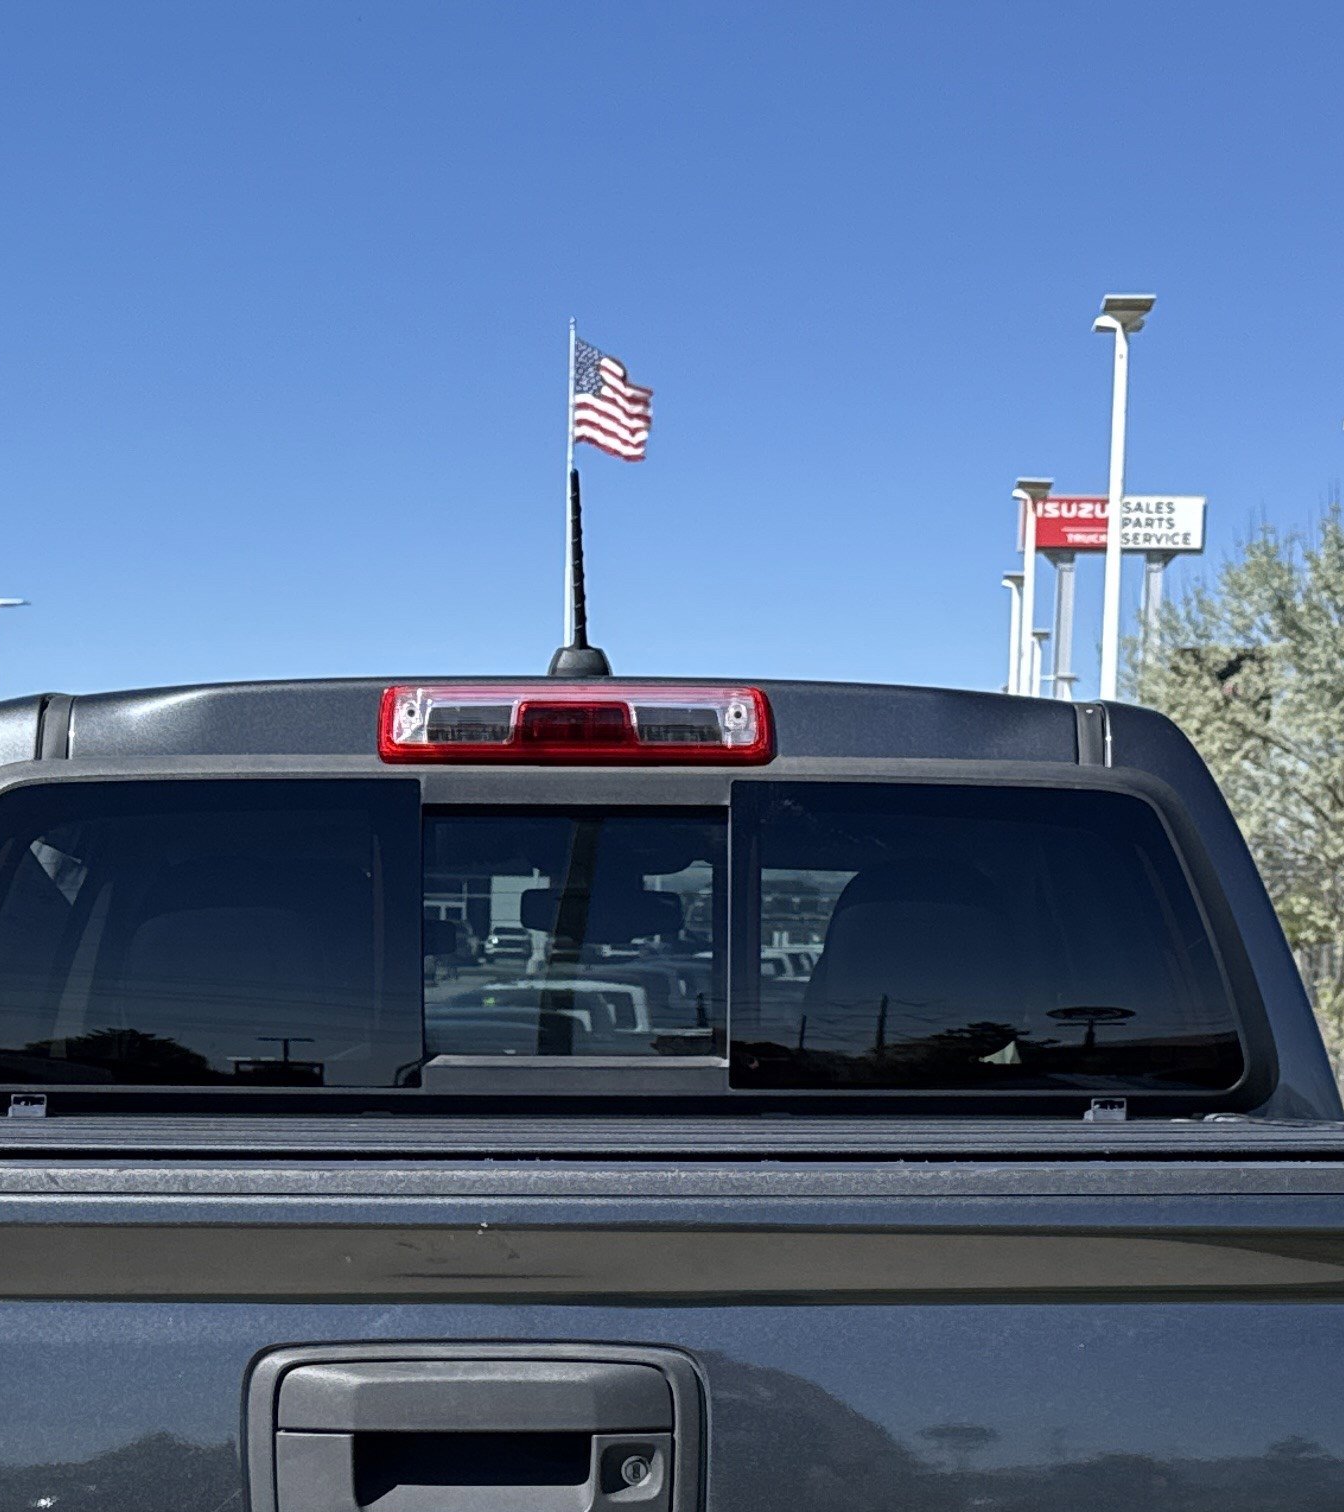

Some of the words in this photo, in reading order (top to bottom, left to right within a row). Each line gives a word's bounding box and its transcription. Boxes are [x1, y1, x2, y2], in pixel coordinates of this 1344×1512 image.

[1037, 501, 1110, 519] ISUZU
[1121, 501, 1176, 514] SALES
[1121, 517, 1176, 530] PARTS
[1120, 532, 1192, 546] SERVICE
